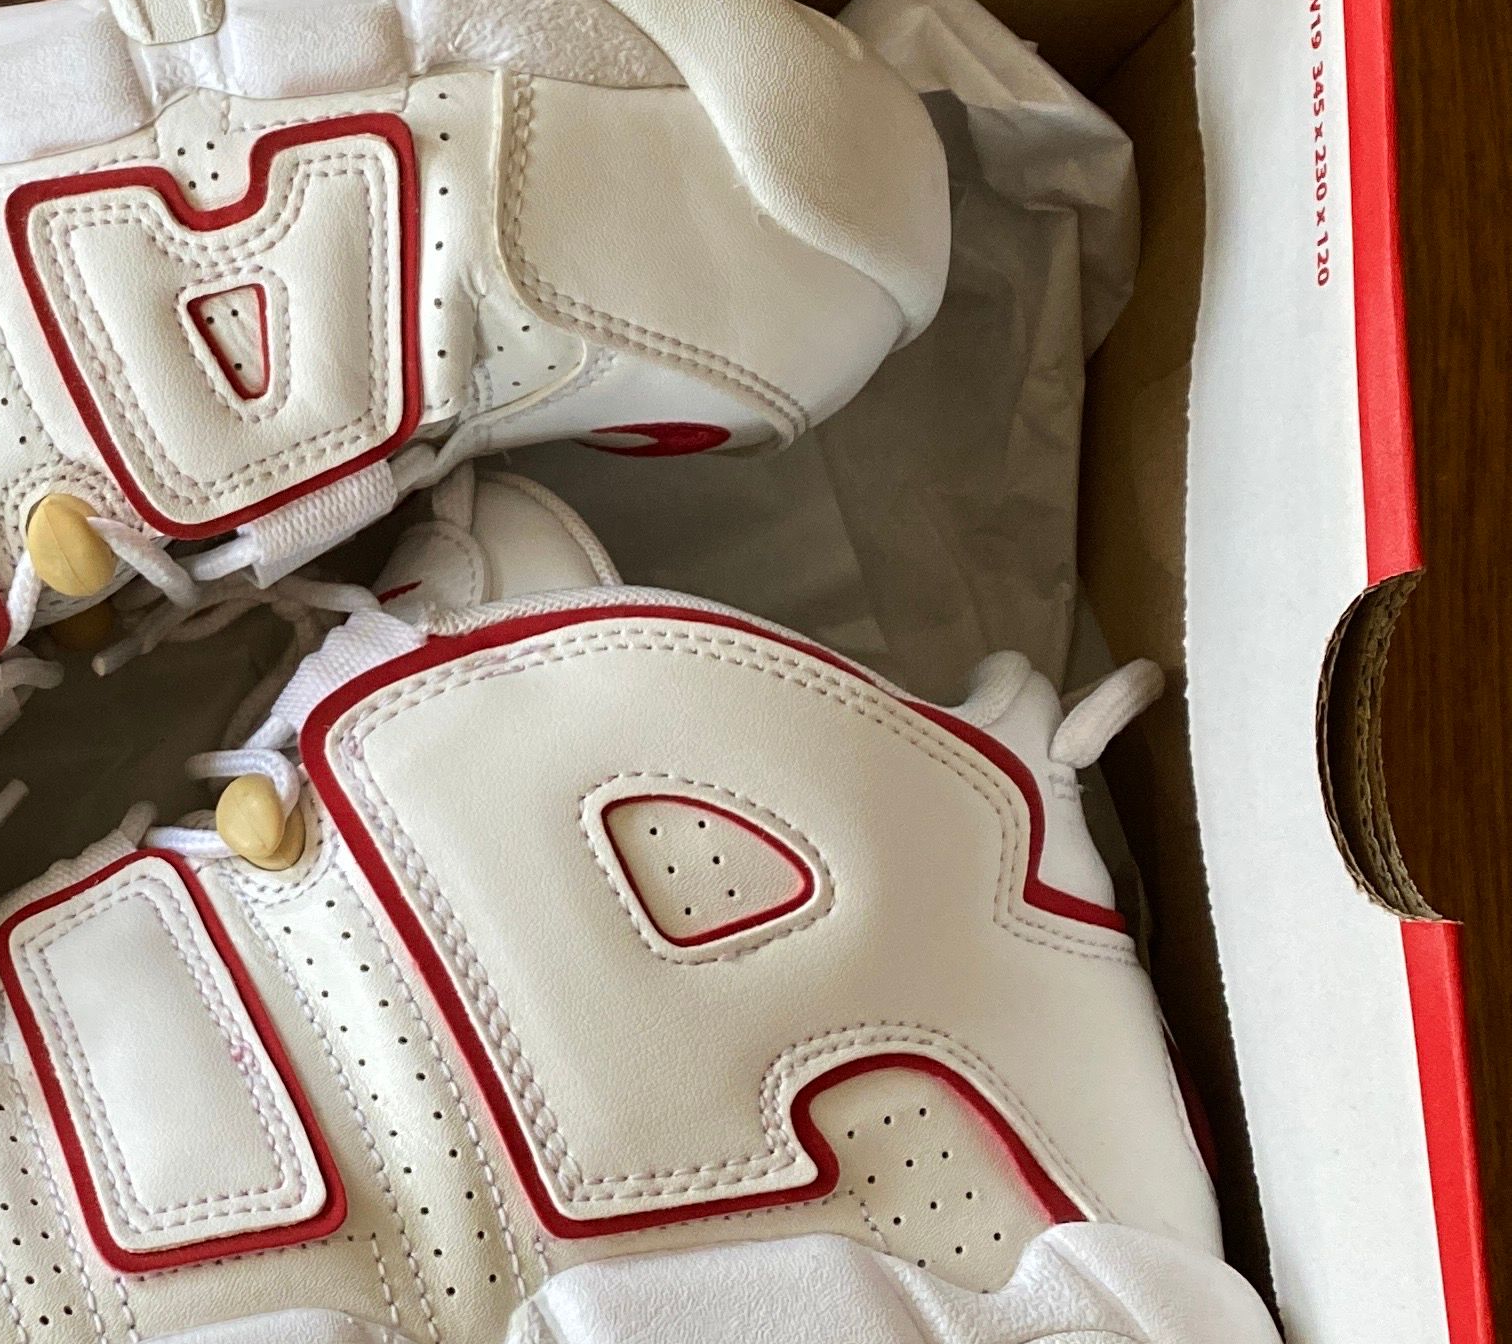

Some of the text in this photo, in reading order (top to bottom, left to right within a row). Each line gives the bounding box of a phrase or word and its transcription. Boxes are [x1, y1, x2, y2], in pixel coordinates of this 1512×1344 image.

[1313, 60, 1325, 117] 345
[1315, 145, 1328, 201] 230
[1317, 231, 1329, 287] 120
